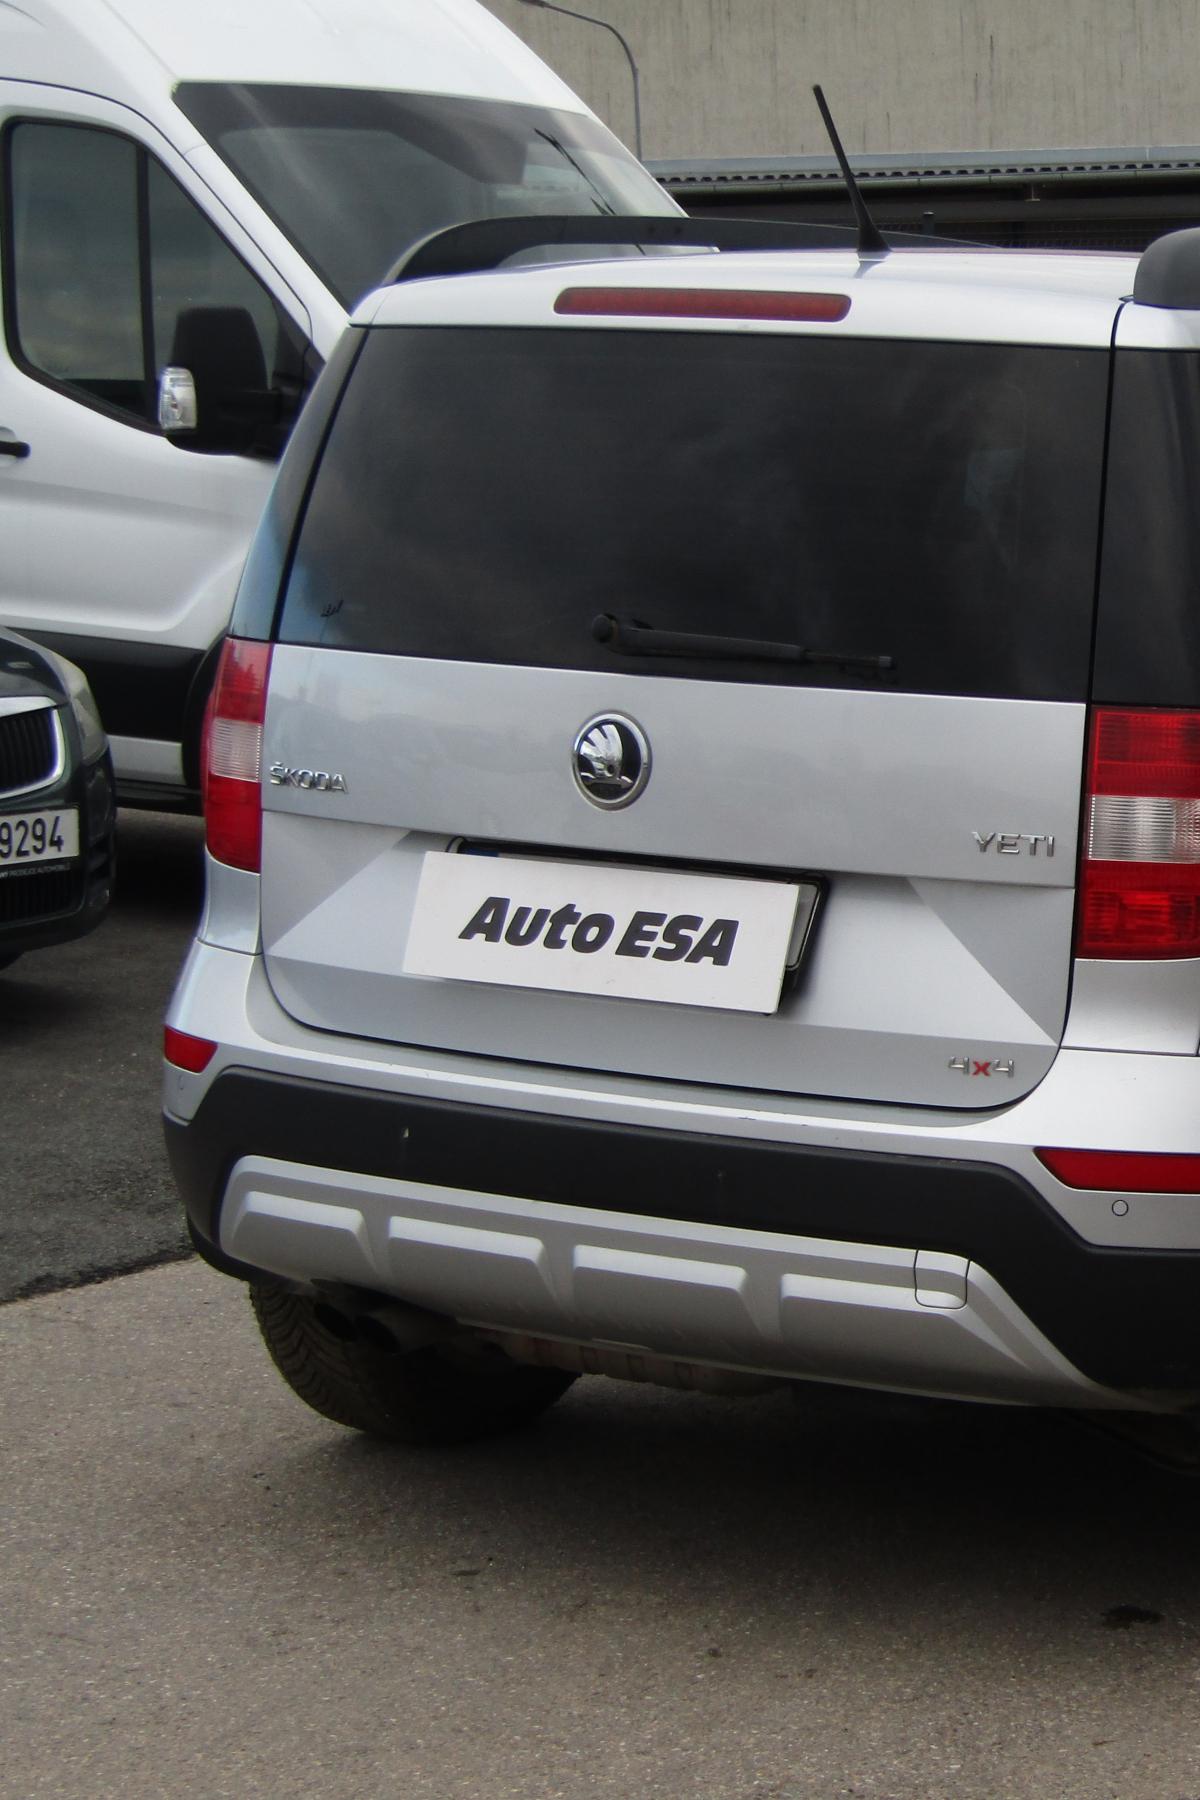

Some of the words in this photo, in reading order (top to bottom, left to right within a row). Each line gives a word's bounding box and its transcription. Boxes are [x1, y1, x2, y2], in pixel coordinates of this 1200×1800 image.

[269, 761, 350, 795] ŠKODA
[0, 816, 64, 858] 9294
[971, 831, 1055, 857] YETI
[458, 896, 615, 954] Auto
[615, 910, 739, 966] ESA
[947, 1055, 1015, 1079] 4x4
